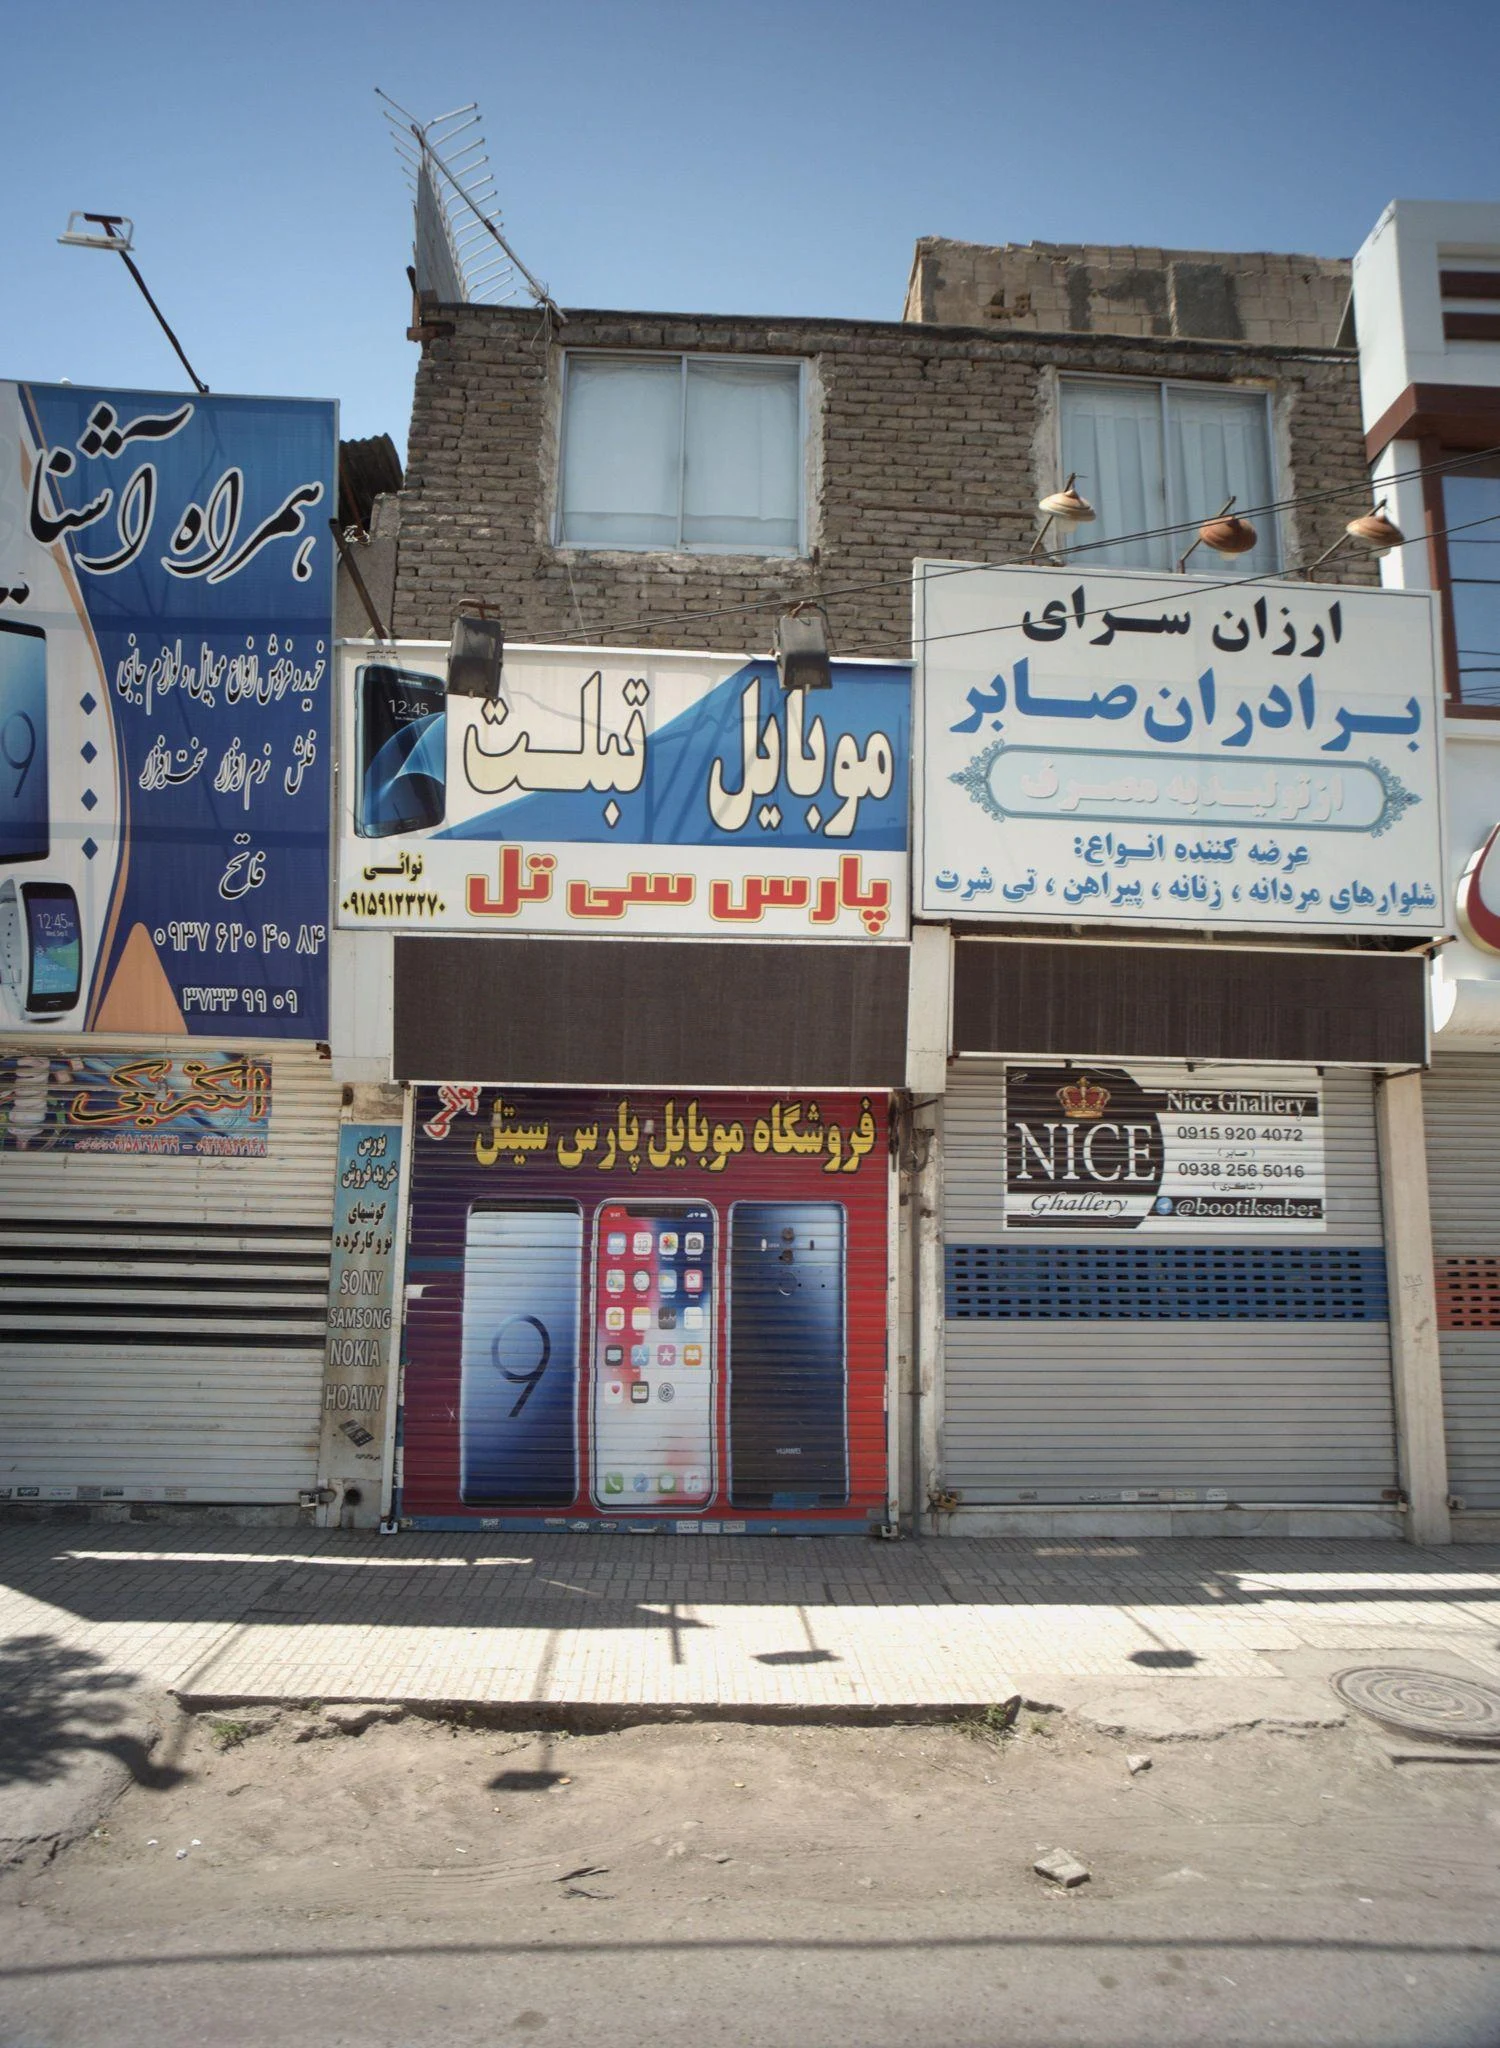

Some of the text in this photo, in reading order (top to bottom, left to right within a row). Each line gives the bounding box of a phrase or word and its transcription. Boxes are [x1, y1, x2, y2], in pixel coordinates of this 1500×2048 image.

[161, 467, 323, 584] همراه
[1022, 584, 1344, 658] ارزان سرای
[117, 633, 147, 704] جانبی
[146, 639, 181, 715] لوازم
[189, 642, 227, 707] موبایل
[226, 635, 258, 704] انواع
[257, 634, 293, 705] فروش
[301, 640, 325, 711] خرید
[388, 700, 429, 716] 12:45
[949, 656, 1423, 753] برادران صابر
[284, 730, 316, 794] فلش
[463, 670, 895, 838] موبایل تبلت
[244, 743, 271, 810] نرم
[1020, 759, 1344, 822] از تولید به مصرف
[219, 833, 266, 900] فاتح
[364, 852, 423, 882] نوائی
[1073, 832, 1310, 872] عرضه کننده انواع:
[465, 844, 891, 937] پارس سی تل
[935, 866, 995, 900] شرت
[1002, 868, 1037, 902] تی
[1063, 871, 1143, 906] پیراهن
[1168, 874, 1223, 909] زنانه
[1249, 876, 1322, 913] مردانه
[1330, 880, 1437, 915] شلوارهای
[154, 921, 326, 954] ۰۹۳۷ ۶۲۰ ۴۰ ۸۴
[183, 987, 297, 1013] ۳۷۳۳ ۹۹ ۰۹
[1166, 1091, 1307, 1121] Nice Ghallery
[357, 1134, 388, 1157] بورس
[475, 1096, 877, 1174] فروشگاه موبایل پارس سیتل
[1177, 1126, 1304, 1142] 0915 920 4072
[1015, 1122, 1156, 1182] NICE
[341, 1158, 399, 1190] خرید فروش
[1178, 1162, 1305, 1178] 0938 256 5016
[1030, 1191, 1128, 1218] Ghallery
[1176, 1197, 1319, 1216] @bootiksaber
[384, 1231, 393, 1254] نو
[339, 1270, 383, 1296] SONY
[328, 1307, 392, 1330] SAMSONG
[329, 1339, 381, 1367] NOKIA
[324, 1383, 384, 1412] HOAWY
